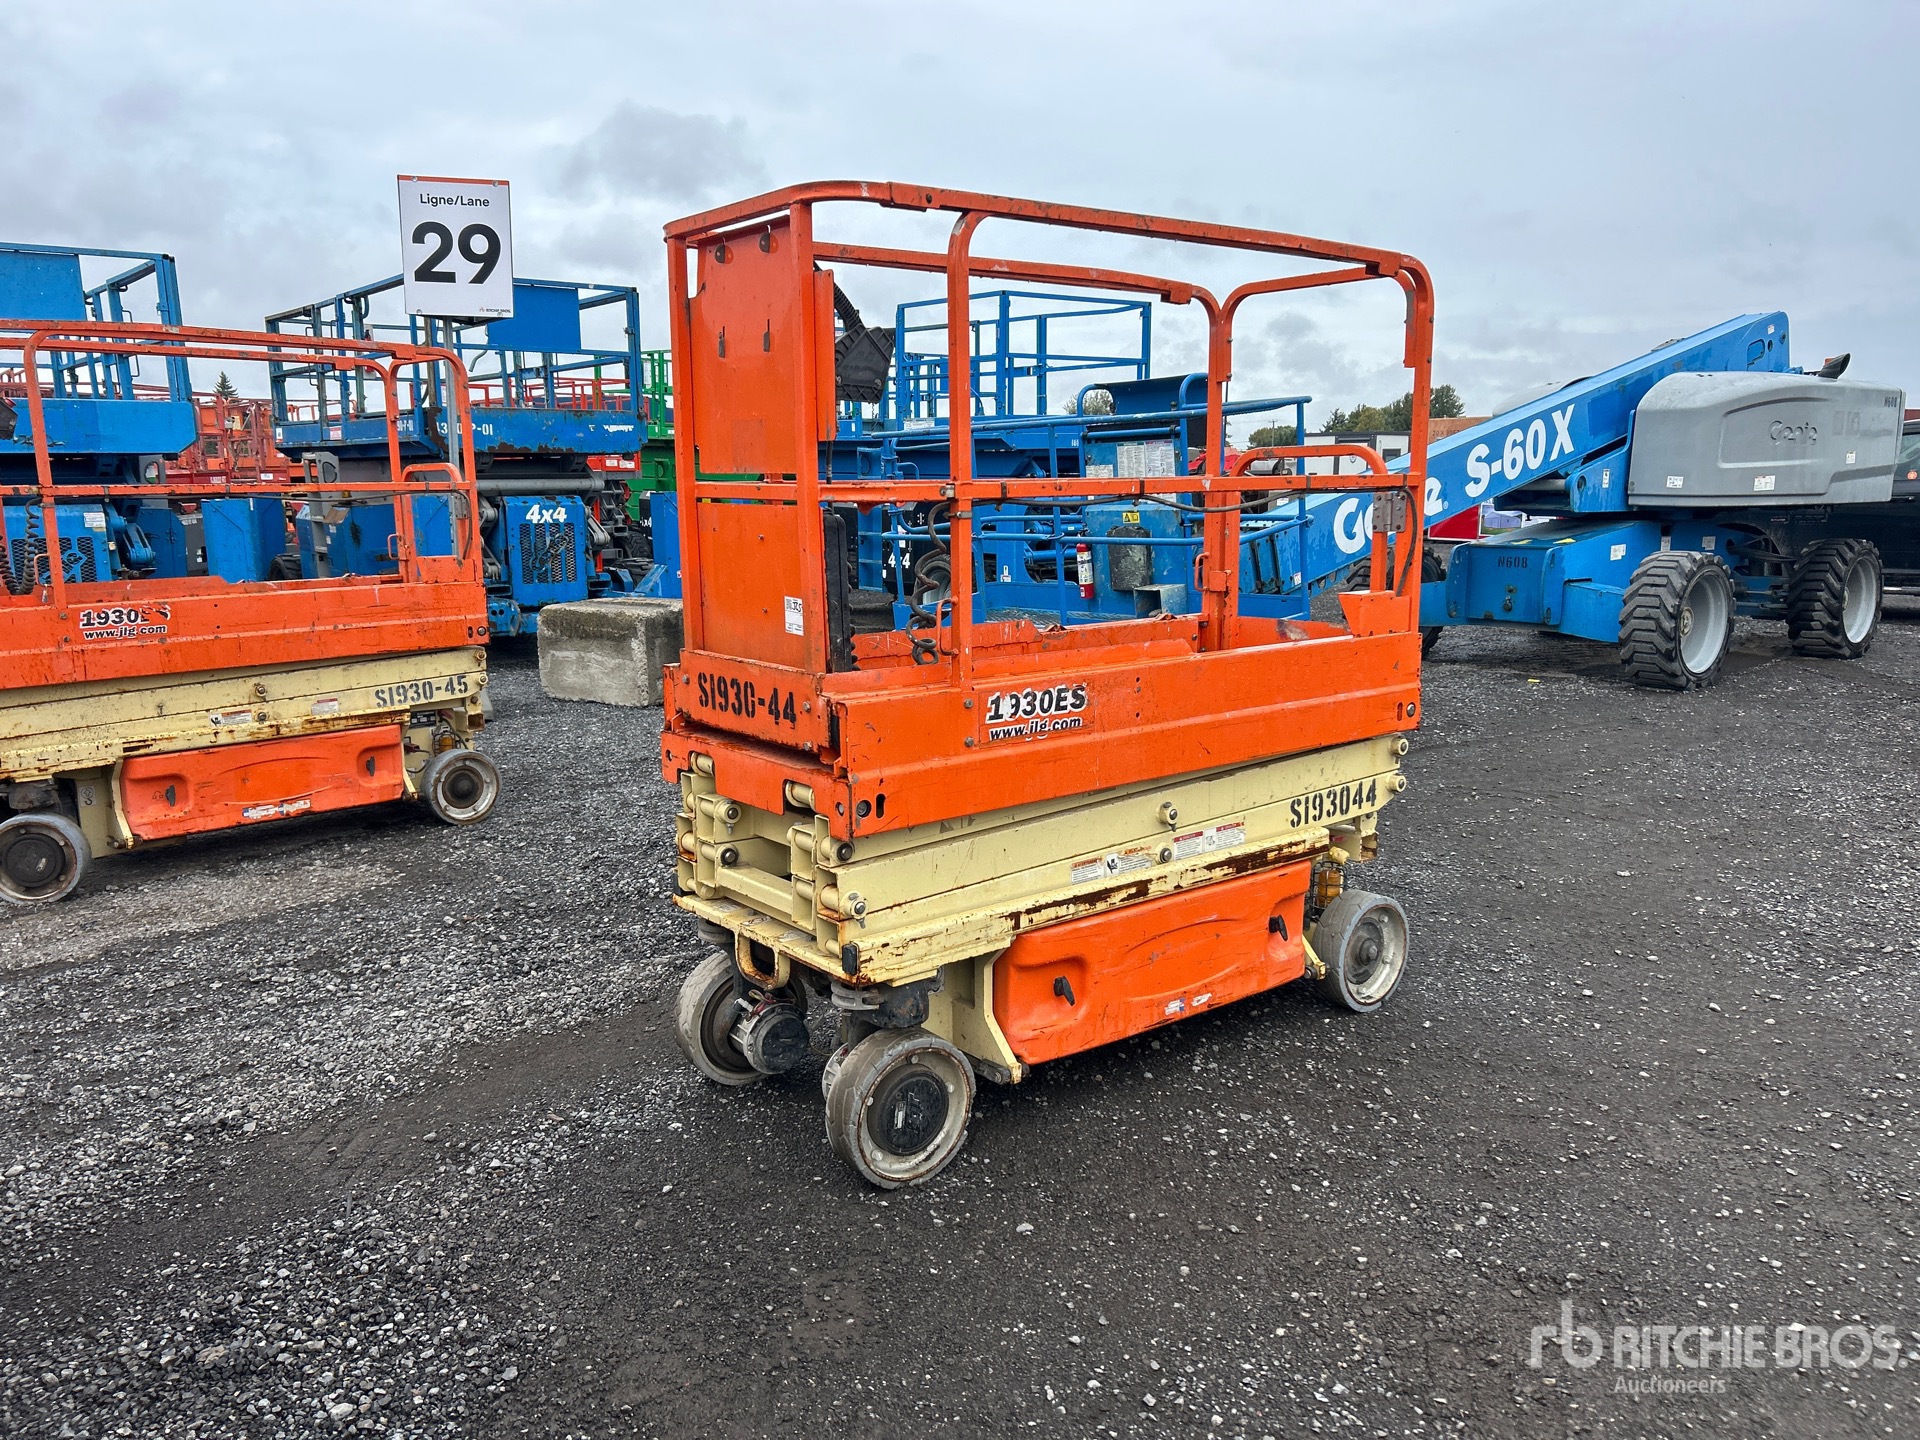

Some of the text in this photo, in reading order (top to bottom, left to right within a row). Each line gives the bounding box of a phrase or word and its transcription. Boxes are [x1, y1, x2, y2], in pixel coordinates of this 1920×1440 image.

[419, 193, 490, 207] Ligne/Lane
[411, 221, 502, 285] 29
[1768, 420, 1818, 446] Genie
[525, 504, 568, 524] 4x4
[887, 552, 911, 569] 44
[1497, 556, 1529, 569] N608
[83, 625, 167, 639] www.jlg.com
[986, 683, 1087, 723] 1930ES
[989, 717, 1083, 741] www.jlg.com
